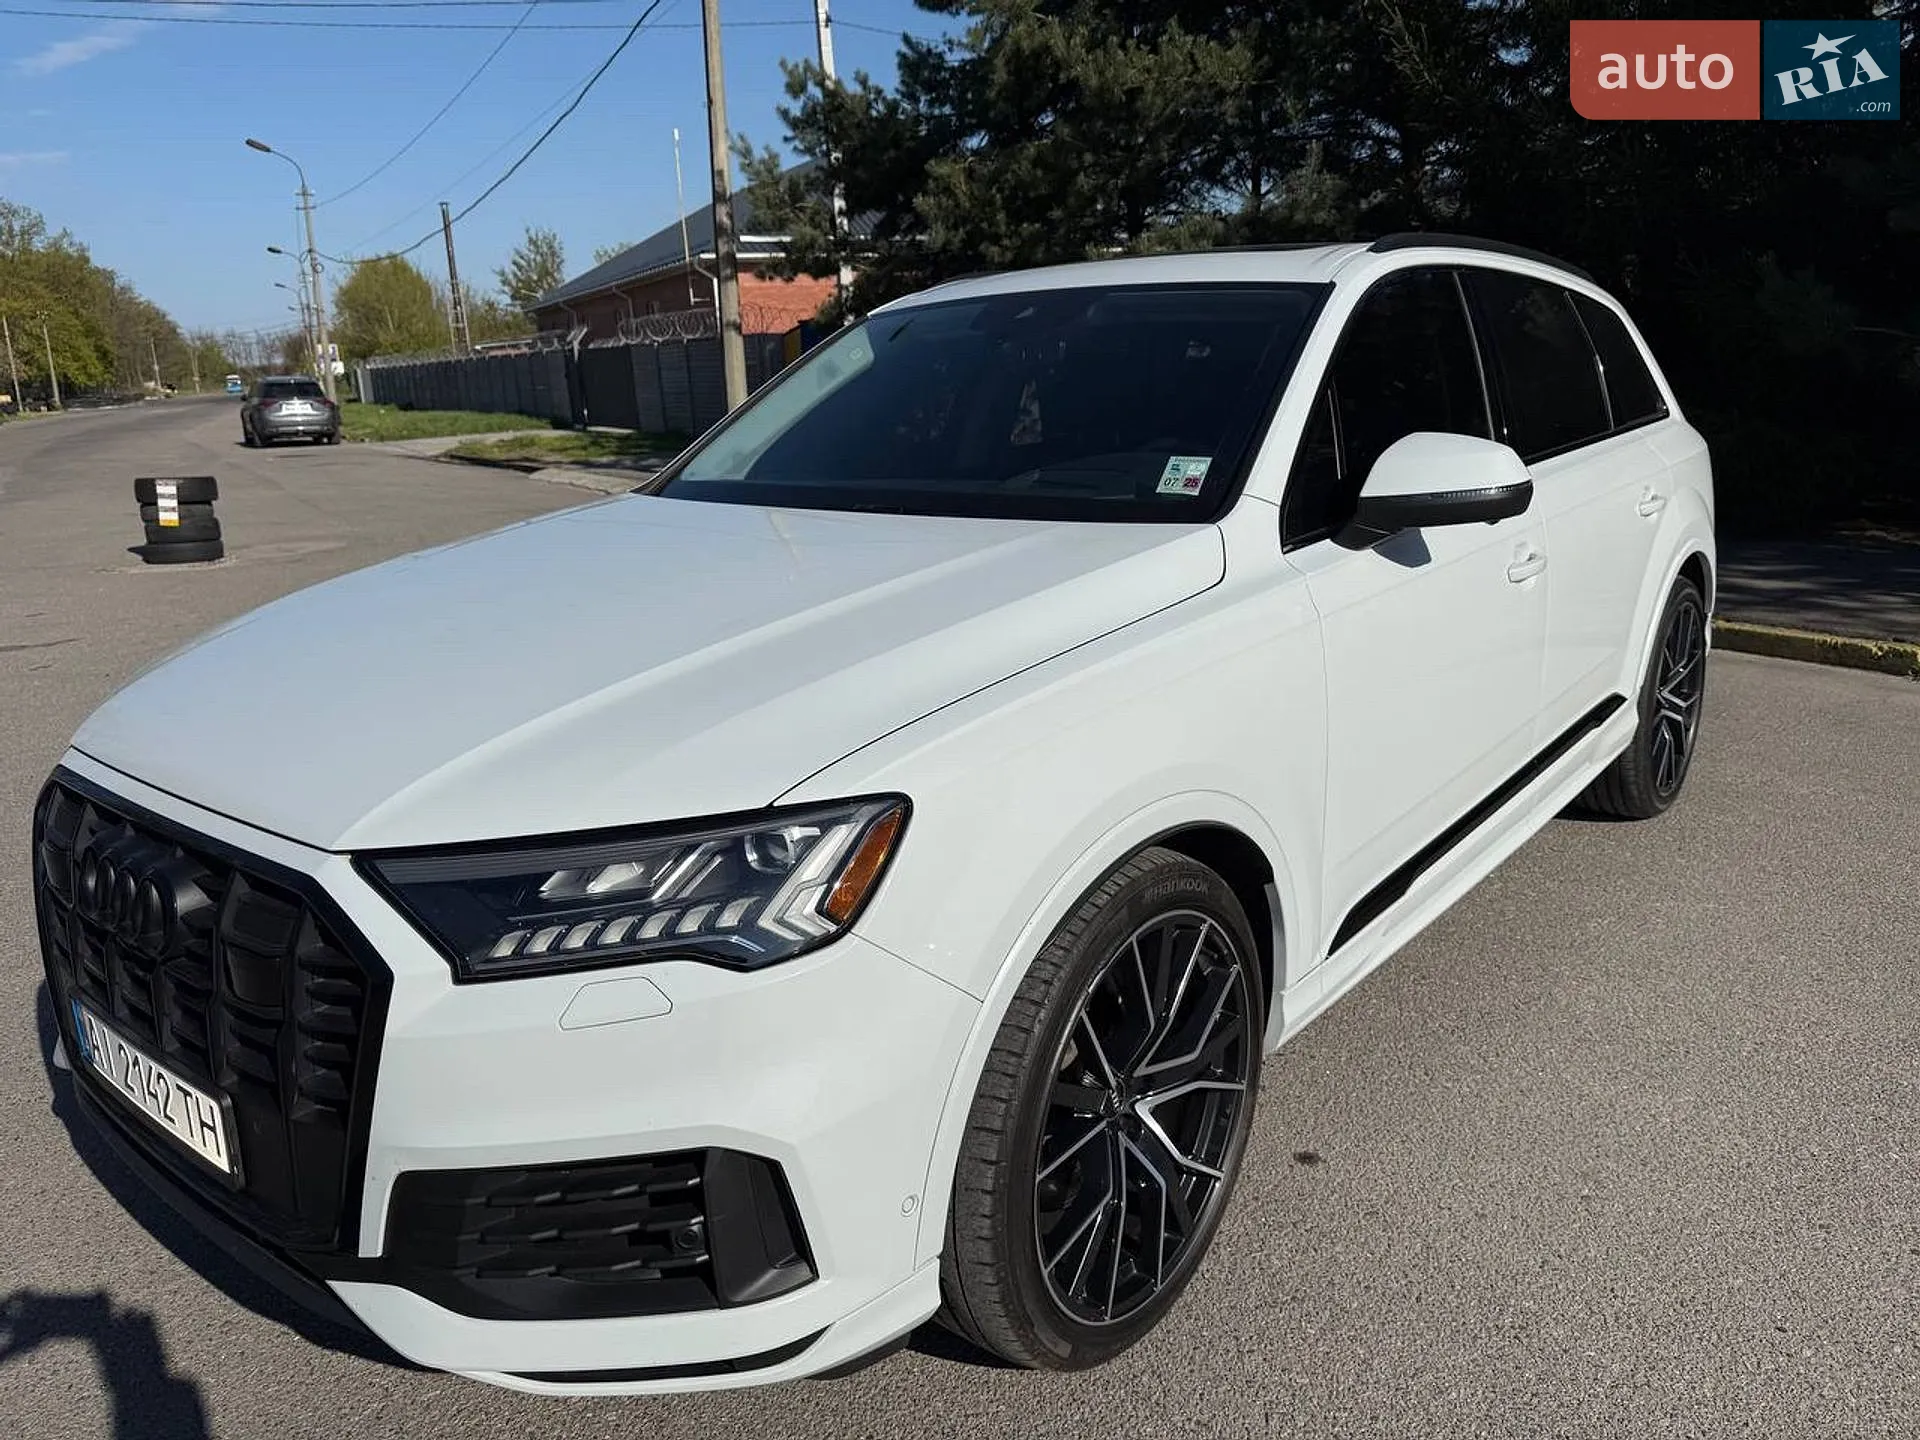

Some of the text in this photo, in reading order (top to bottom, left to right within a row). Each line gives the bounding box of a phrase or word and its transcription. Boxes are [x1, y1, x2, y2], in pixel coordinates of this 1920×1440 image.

[86, 1014, 221, 1158] AI 2142 TH
